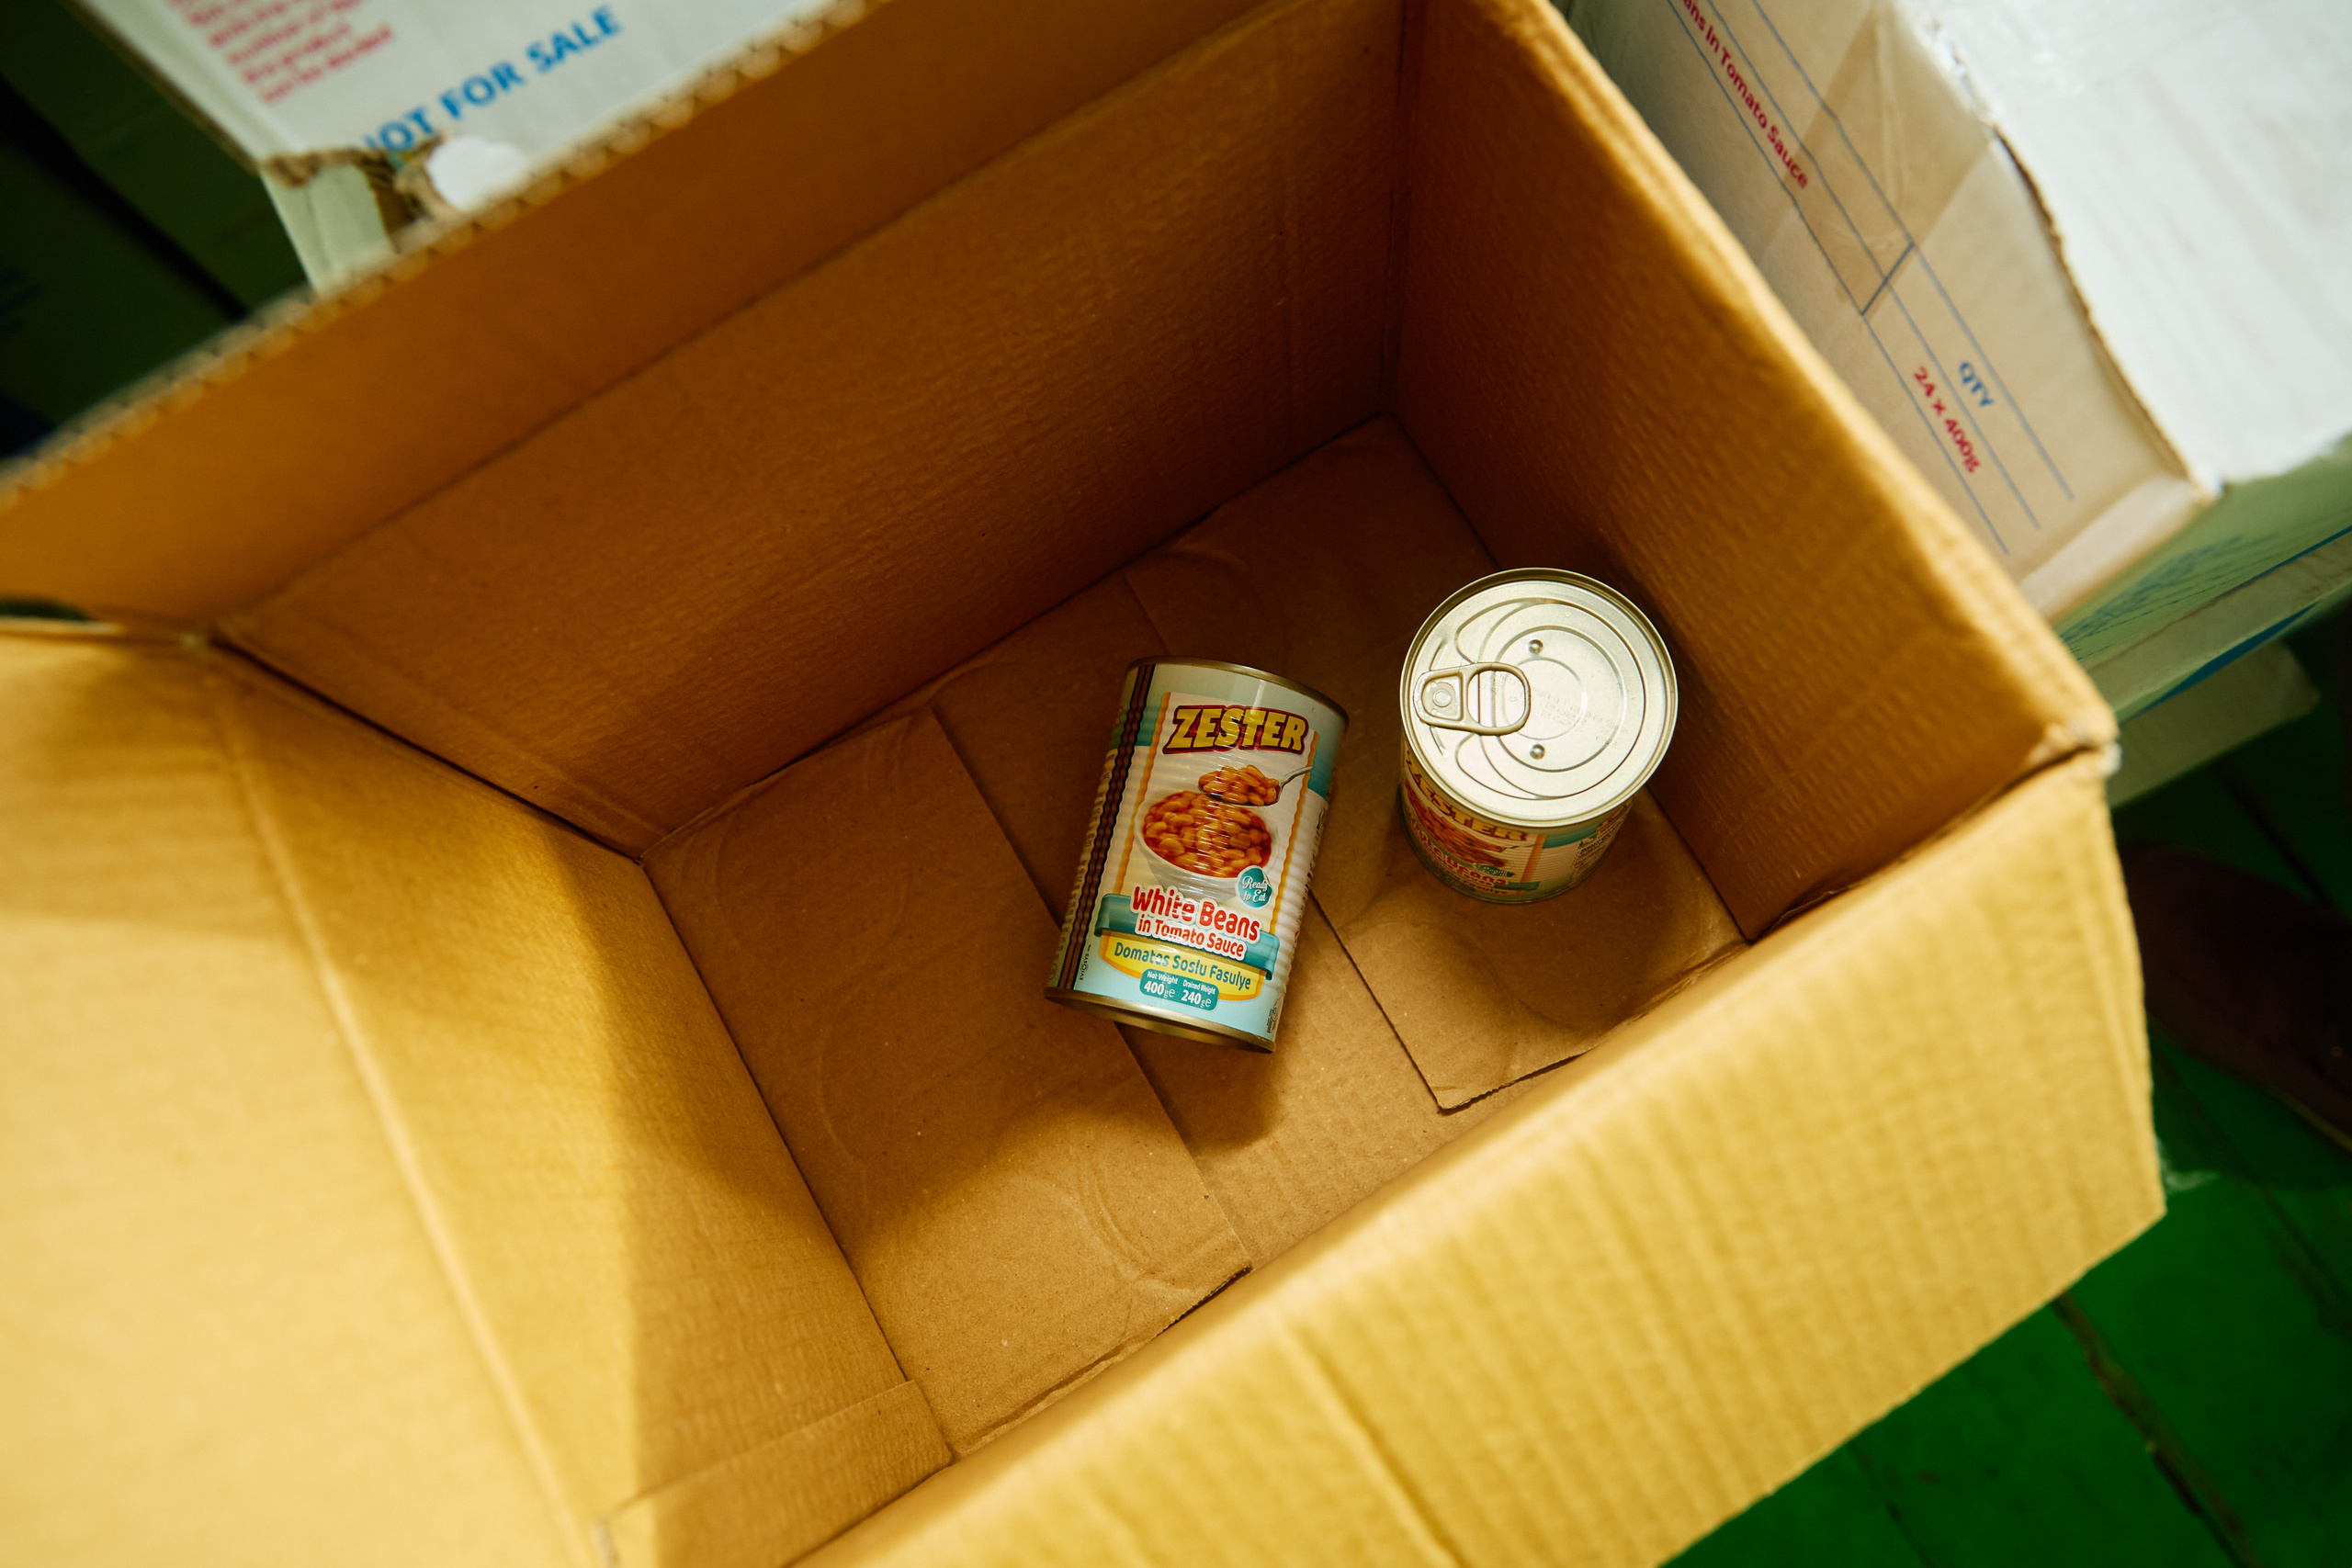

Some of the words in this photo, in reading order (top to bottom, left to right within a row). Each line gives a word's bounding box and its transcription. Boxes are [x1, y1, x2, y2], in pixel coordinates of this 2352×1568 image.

[437, 60, 527, 121] FOR
[526, 5, 622, 75] SALE
[1721, 46, 1768, 129] Tomato
[1768, 125, 1808, 189] Sauce
[1959, 361, 1994, 407] QTY
[1914, 365, 1936, 398] 24
[1945, 418, 1981, 473] 400g
[1164, 705, 1308, 755] ZESTER
[1242, 875, 1268, 892] Ready
[1243, 891, 1251, 901] to
[1252, 889, 1267, 902] Eat
[1133, 886, 1195, 922] White
[1199, 901, 1260, 941] Beans
[1138, 914, 1151, 933] in
[1155, 919, 1205, 946] Tomato
[1206, 933, 1244, 957] Sauce
[1114, 942, 1170, 967] Domates
[1171, 955, 1207, 976] Soslu
[1209, 964, 1251, 991] Fasulye
[1147, 971, 1158, 980] Net
[1158, 974, 1179, 985] Weight
